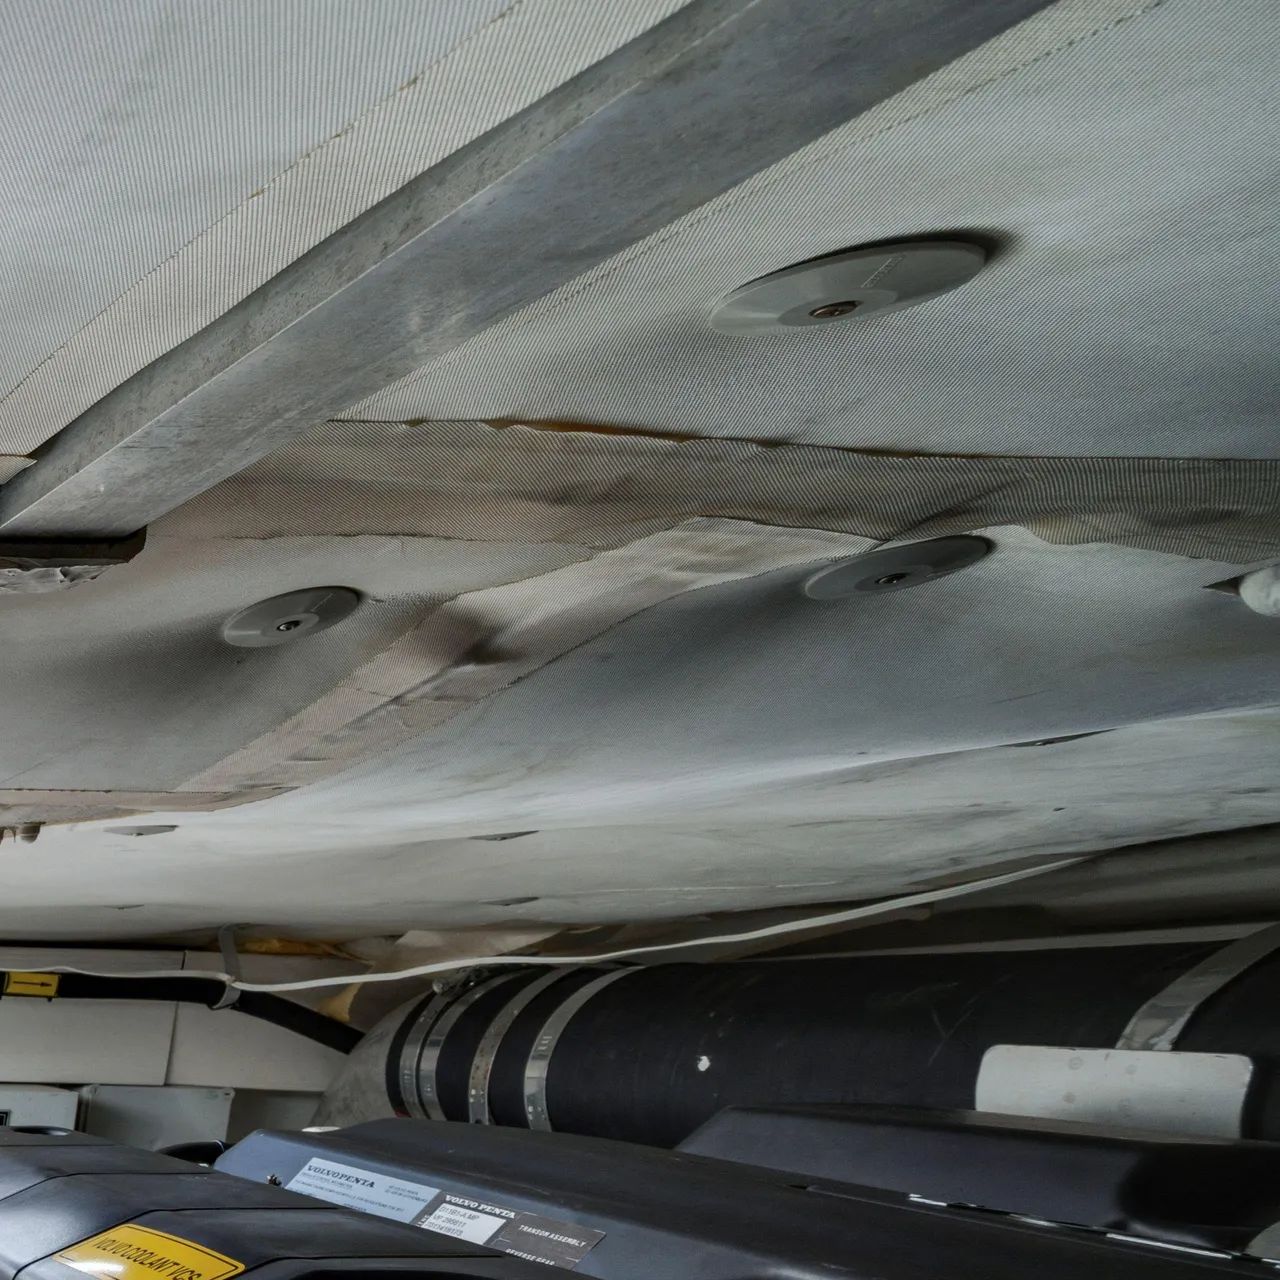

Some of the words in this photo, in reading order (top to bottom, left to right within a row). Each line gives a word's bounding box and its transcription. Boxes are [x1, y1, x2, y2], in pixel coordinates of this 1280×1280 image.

[306, 1164, 341, 1179] VOLVO
[338, 1173, 377, 1189] PENTA
[444, 1194, 479, 1209] VOLVO
[478, 1203, 517, 1219] PENTA
[517, 1223, 552, 1240] TRANSOM
[547, 1231, 588, 1249] ASSEMBLY
[92, 1236, 132, 1259] VOLVO
[126, 1246, 181, 1274] COOLANT
